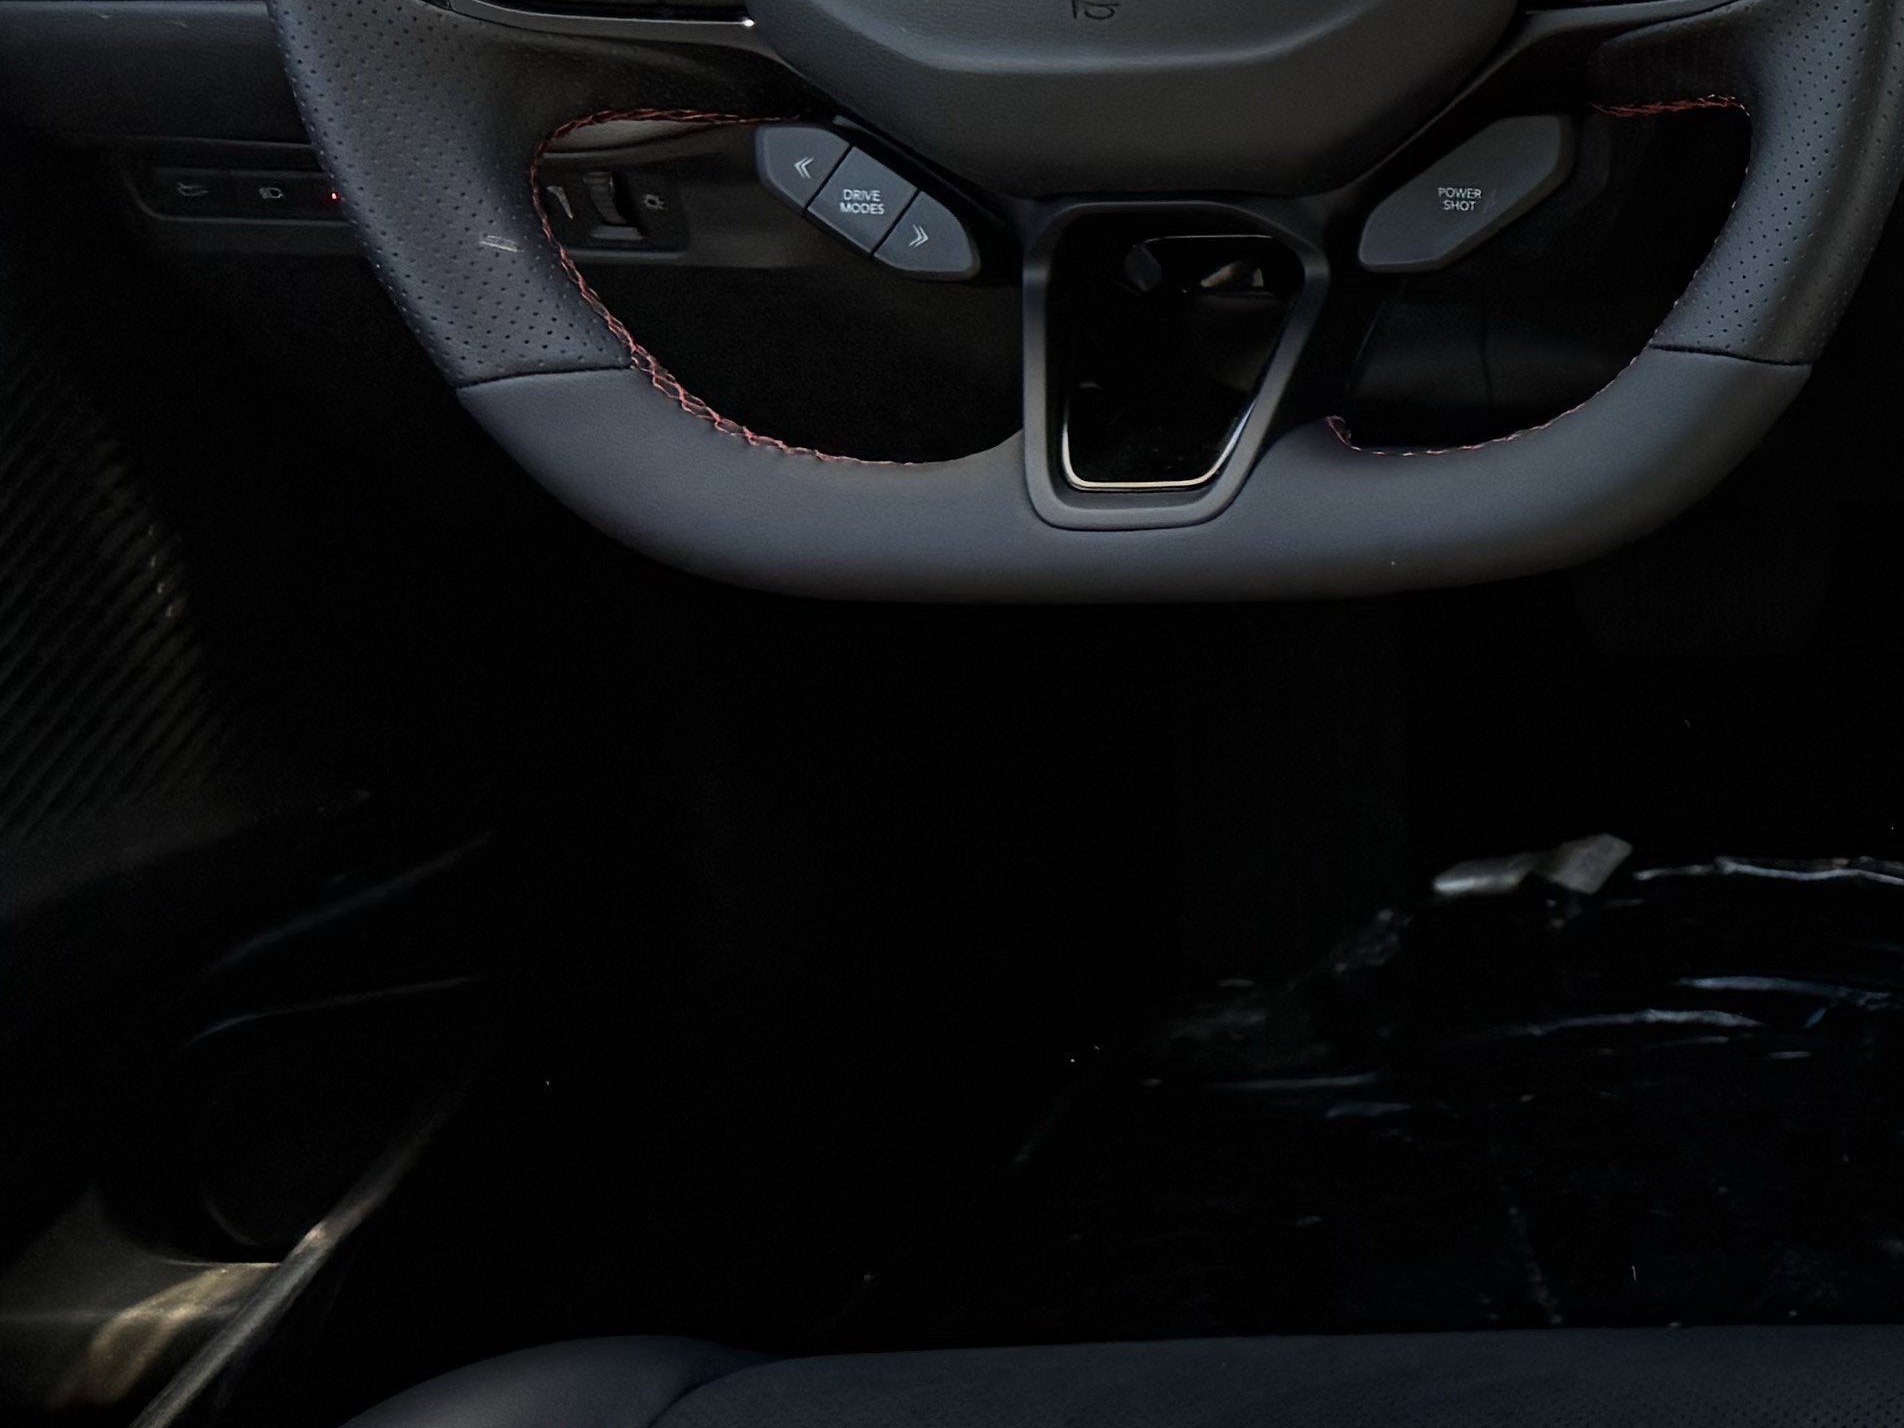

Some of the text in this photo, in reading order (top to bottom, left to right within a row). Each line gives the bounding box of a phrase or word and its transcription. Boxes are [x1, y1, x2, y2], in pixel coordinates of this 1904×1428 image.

[842, 188, 881, 204] DRIVE
[1438, 187, 1482, 201] POWER
[839, 199, 885, 215] MODES
[1443, 199, 1476, 212] SHOT
